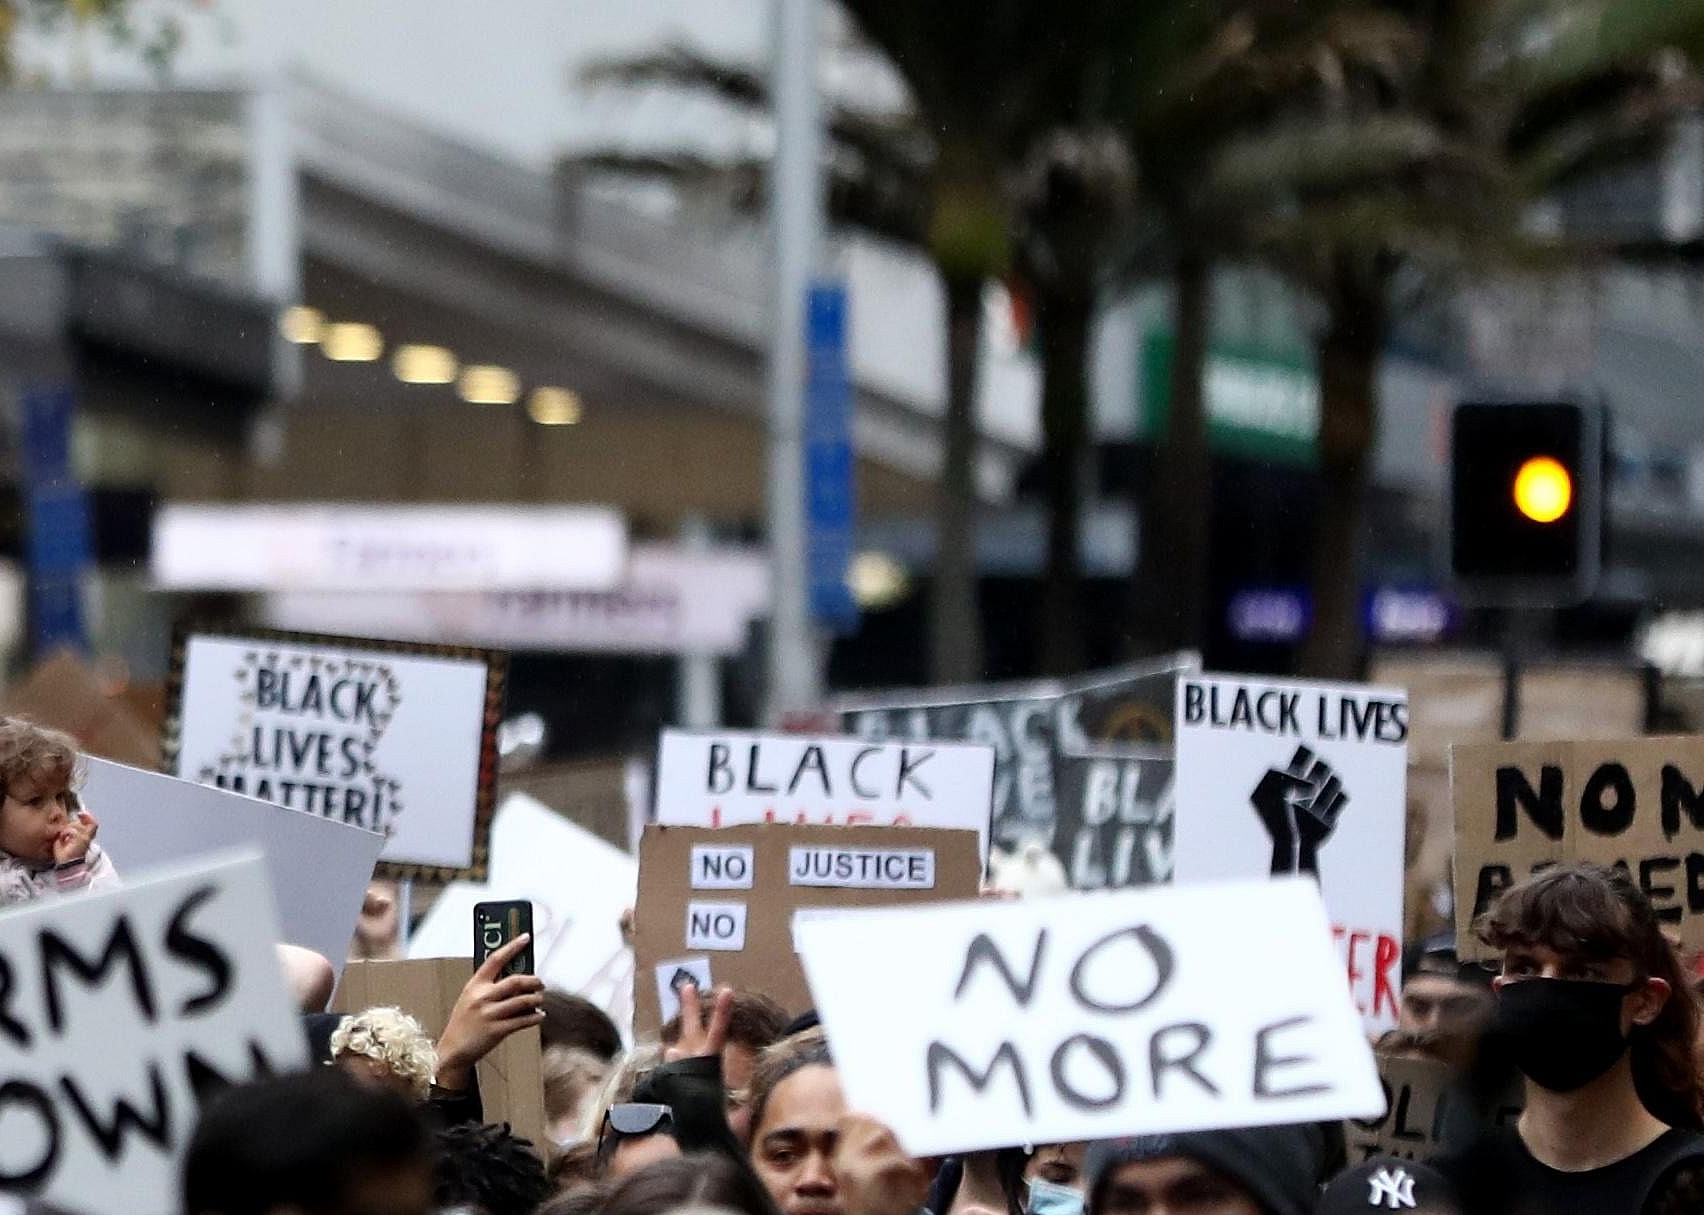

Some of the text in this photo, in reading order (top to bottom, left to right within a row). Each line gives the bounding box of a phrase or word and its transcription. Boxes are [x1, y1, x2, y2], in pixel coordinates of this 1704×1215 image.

[255, 668, 379, 728] BLACK
[1184, 683, 1408, 744] BLACK LIVES
[251, 726, 359, 779] LIVES
[706, 743, 935, 801] BLACK
[1494, 762, 1637, 841] NO
[701, 851, 928, 884] NO JUSTICE
[690, 911, 736, 940] NO
[953, 922, 1176, 1016] NO
[926, 1015, 1332, 1119] MORE
